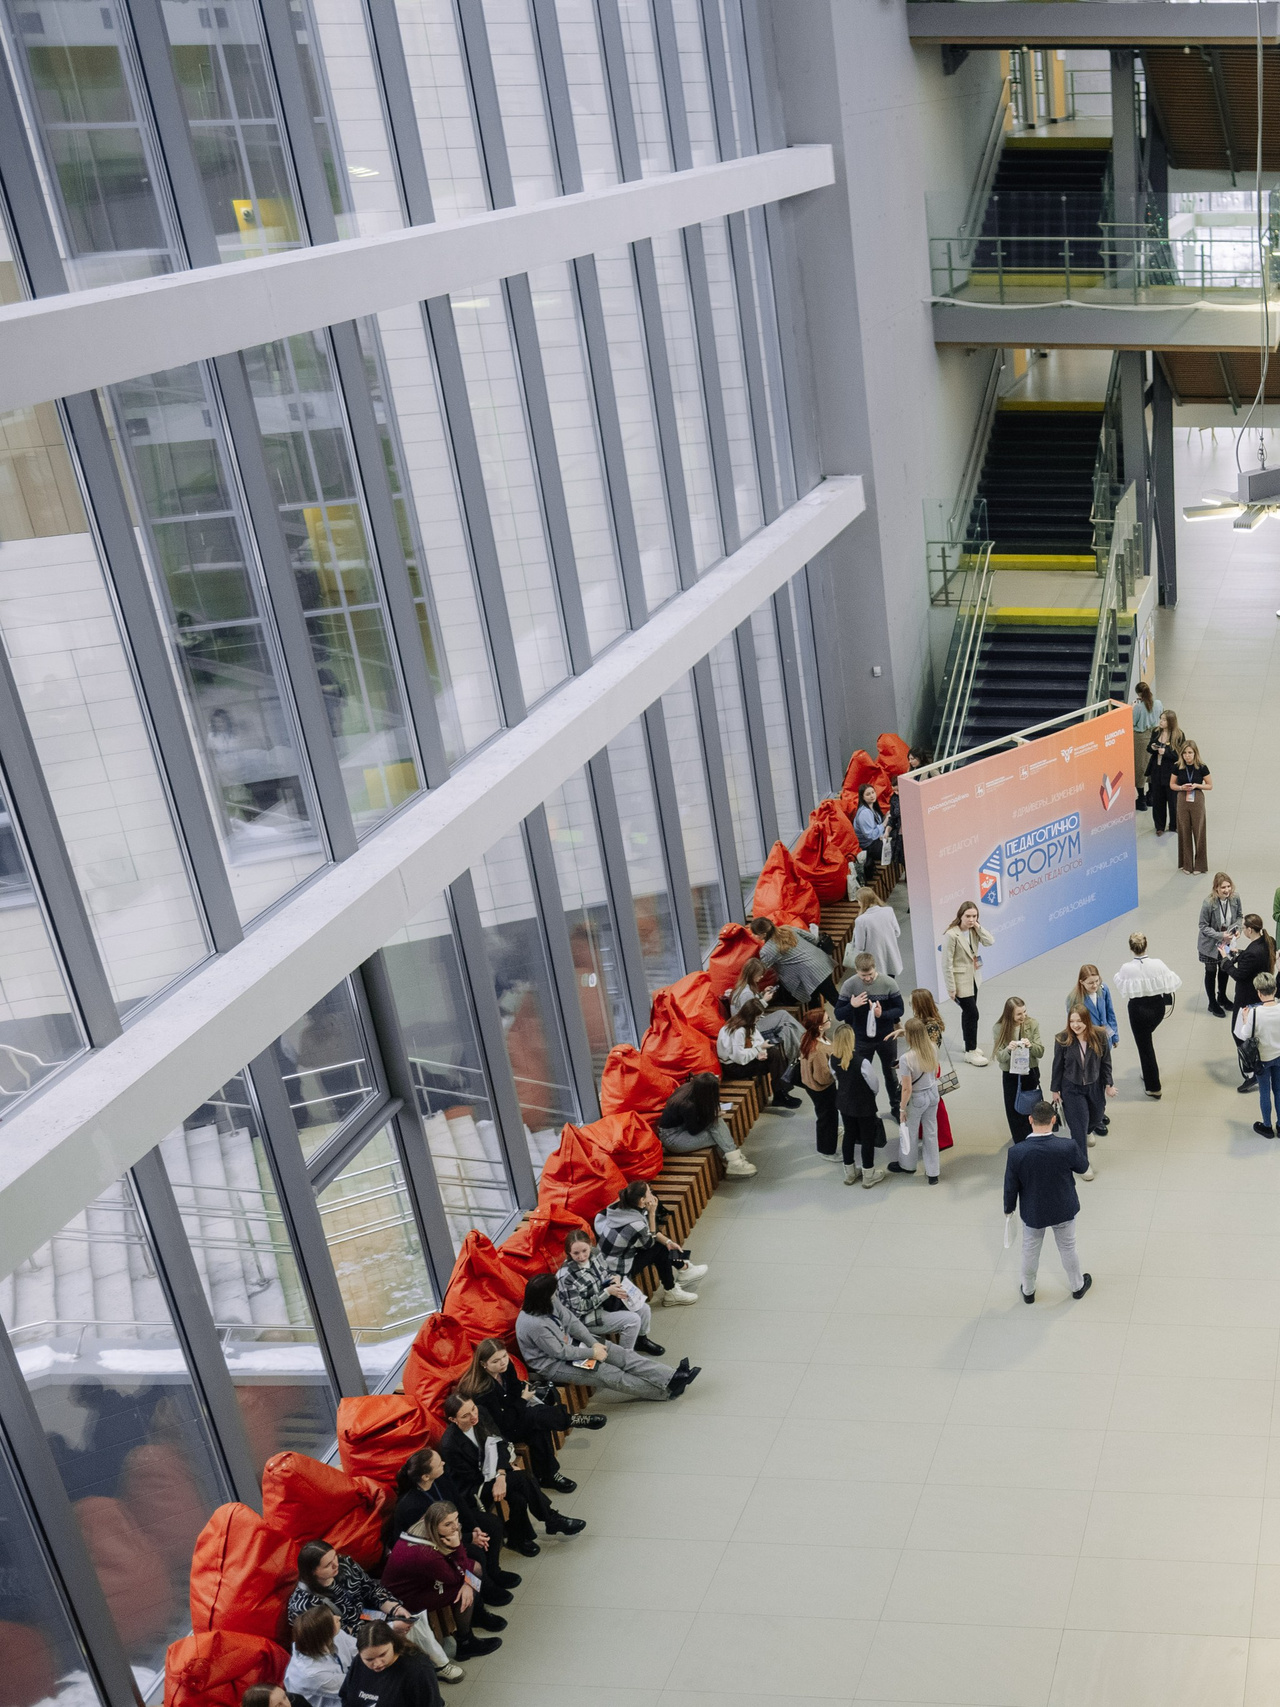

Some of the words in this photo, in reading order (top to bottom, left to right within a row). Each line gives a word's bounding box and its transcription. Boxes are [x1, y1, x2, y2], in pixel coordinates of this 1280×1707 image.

[938, 834, 980, 858] #ПЕДАГОГИ
[1006, 815, 1079, 856] ПЕДАГОГИЧНО
[1007, 831, 1082, 882] ФОРУМ
[1008, 877, 1044, 899] МОЛОДЫХ
[1044, 858, 1084, 882] ПЕДАГОГОВ
[1048, 892, 1097, 922] #ОБРАЗОВАНИЕ
